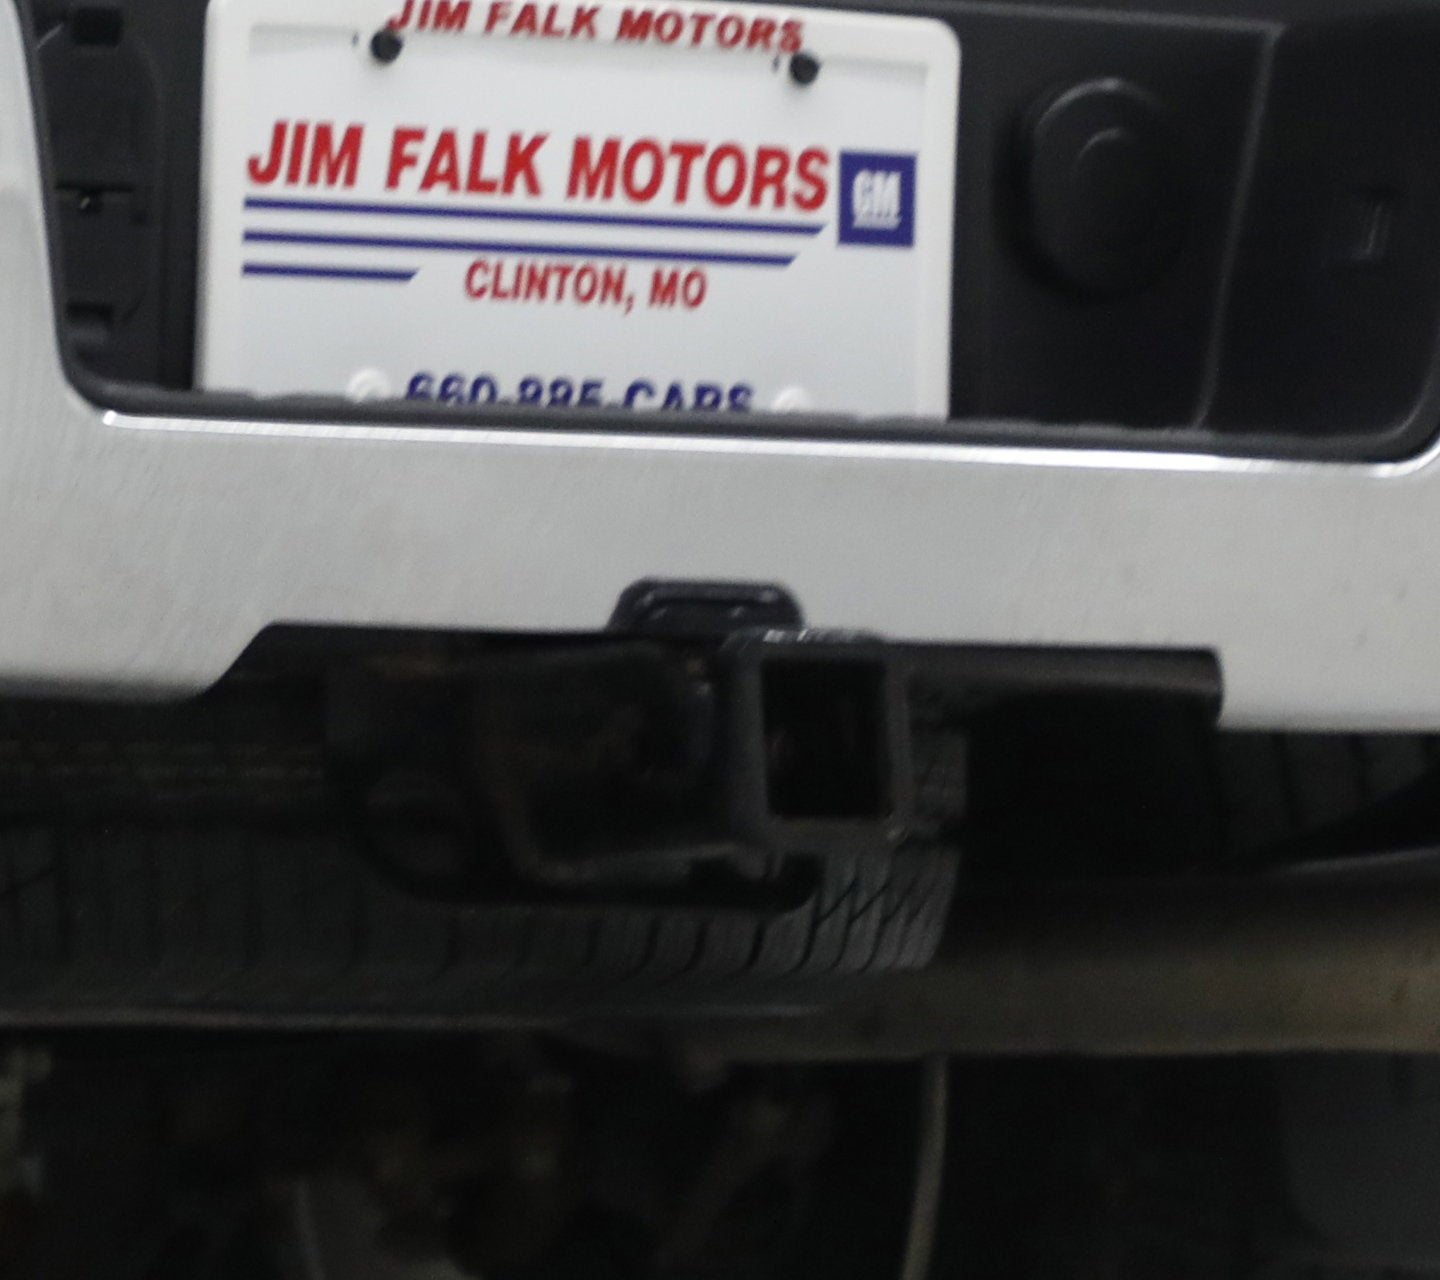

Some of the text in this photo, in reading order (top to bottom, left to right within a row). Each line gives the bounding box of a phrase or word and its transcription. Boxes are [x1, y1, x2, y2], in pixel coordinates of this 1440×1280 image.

[483, 0, 601, 40] FALK
[617, 7, 804, 54] MOTORS
[247, 119, 829, 212] JIM FALK MOTORS
[464, 257, 709, 317] CLINTON, MO
